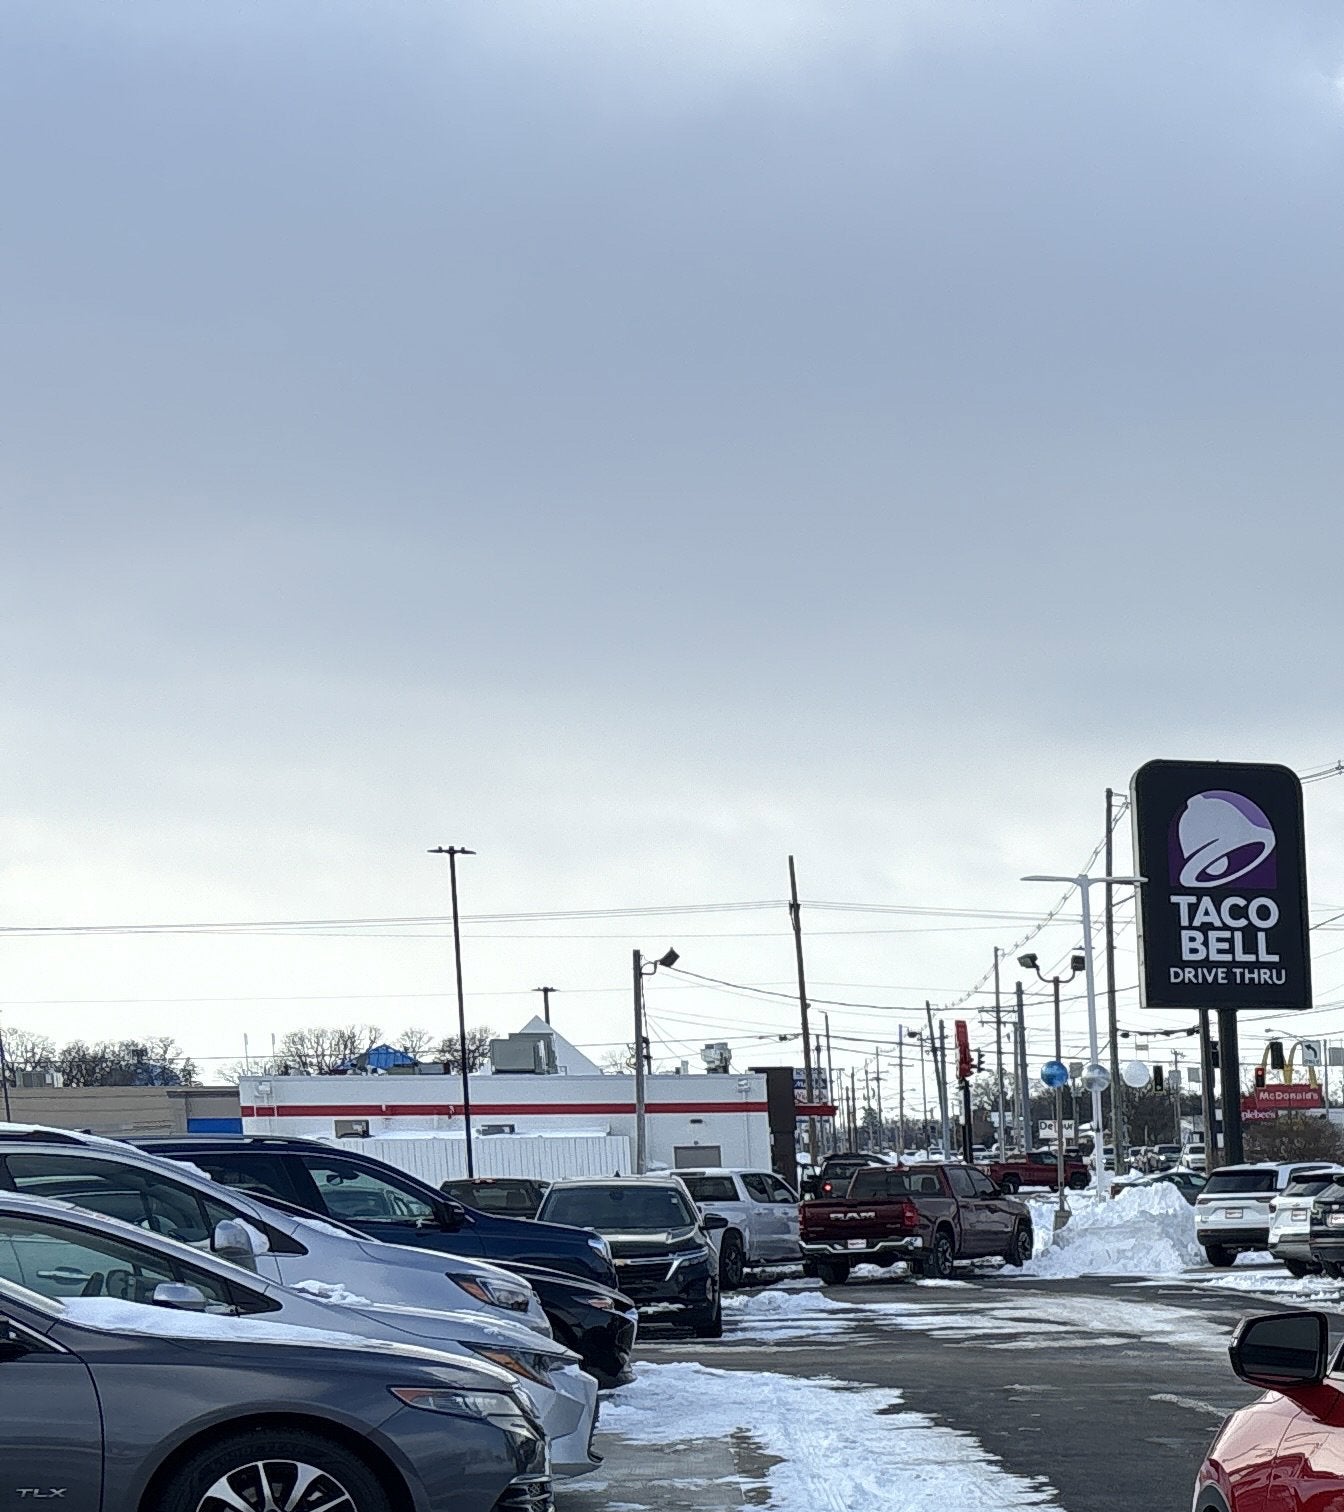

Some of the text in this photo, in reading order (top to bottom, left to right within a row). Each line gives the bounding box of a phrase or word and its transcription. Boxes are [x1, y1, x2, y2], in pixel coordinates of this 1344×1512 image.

[1170, 895, 1280, 929] TACO
[1181, 930, 1280, 962] BELL
[1169, 967, 1286, 985] DRIVE THRU
[1259, 1091, 1319, 1101] McDonald's
[16, 1488, 68, 1498] TLX
